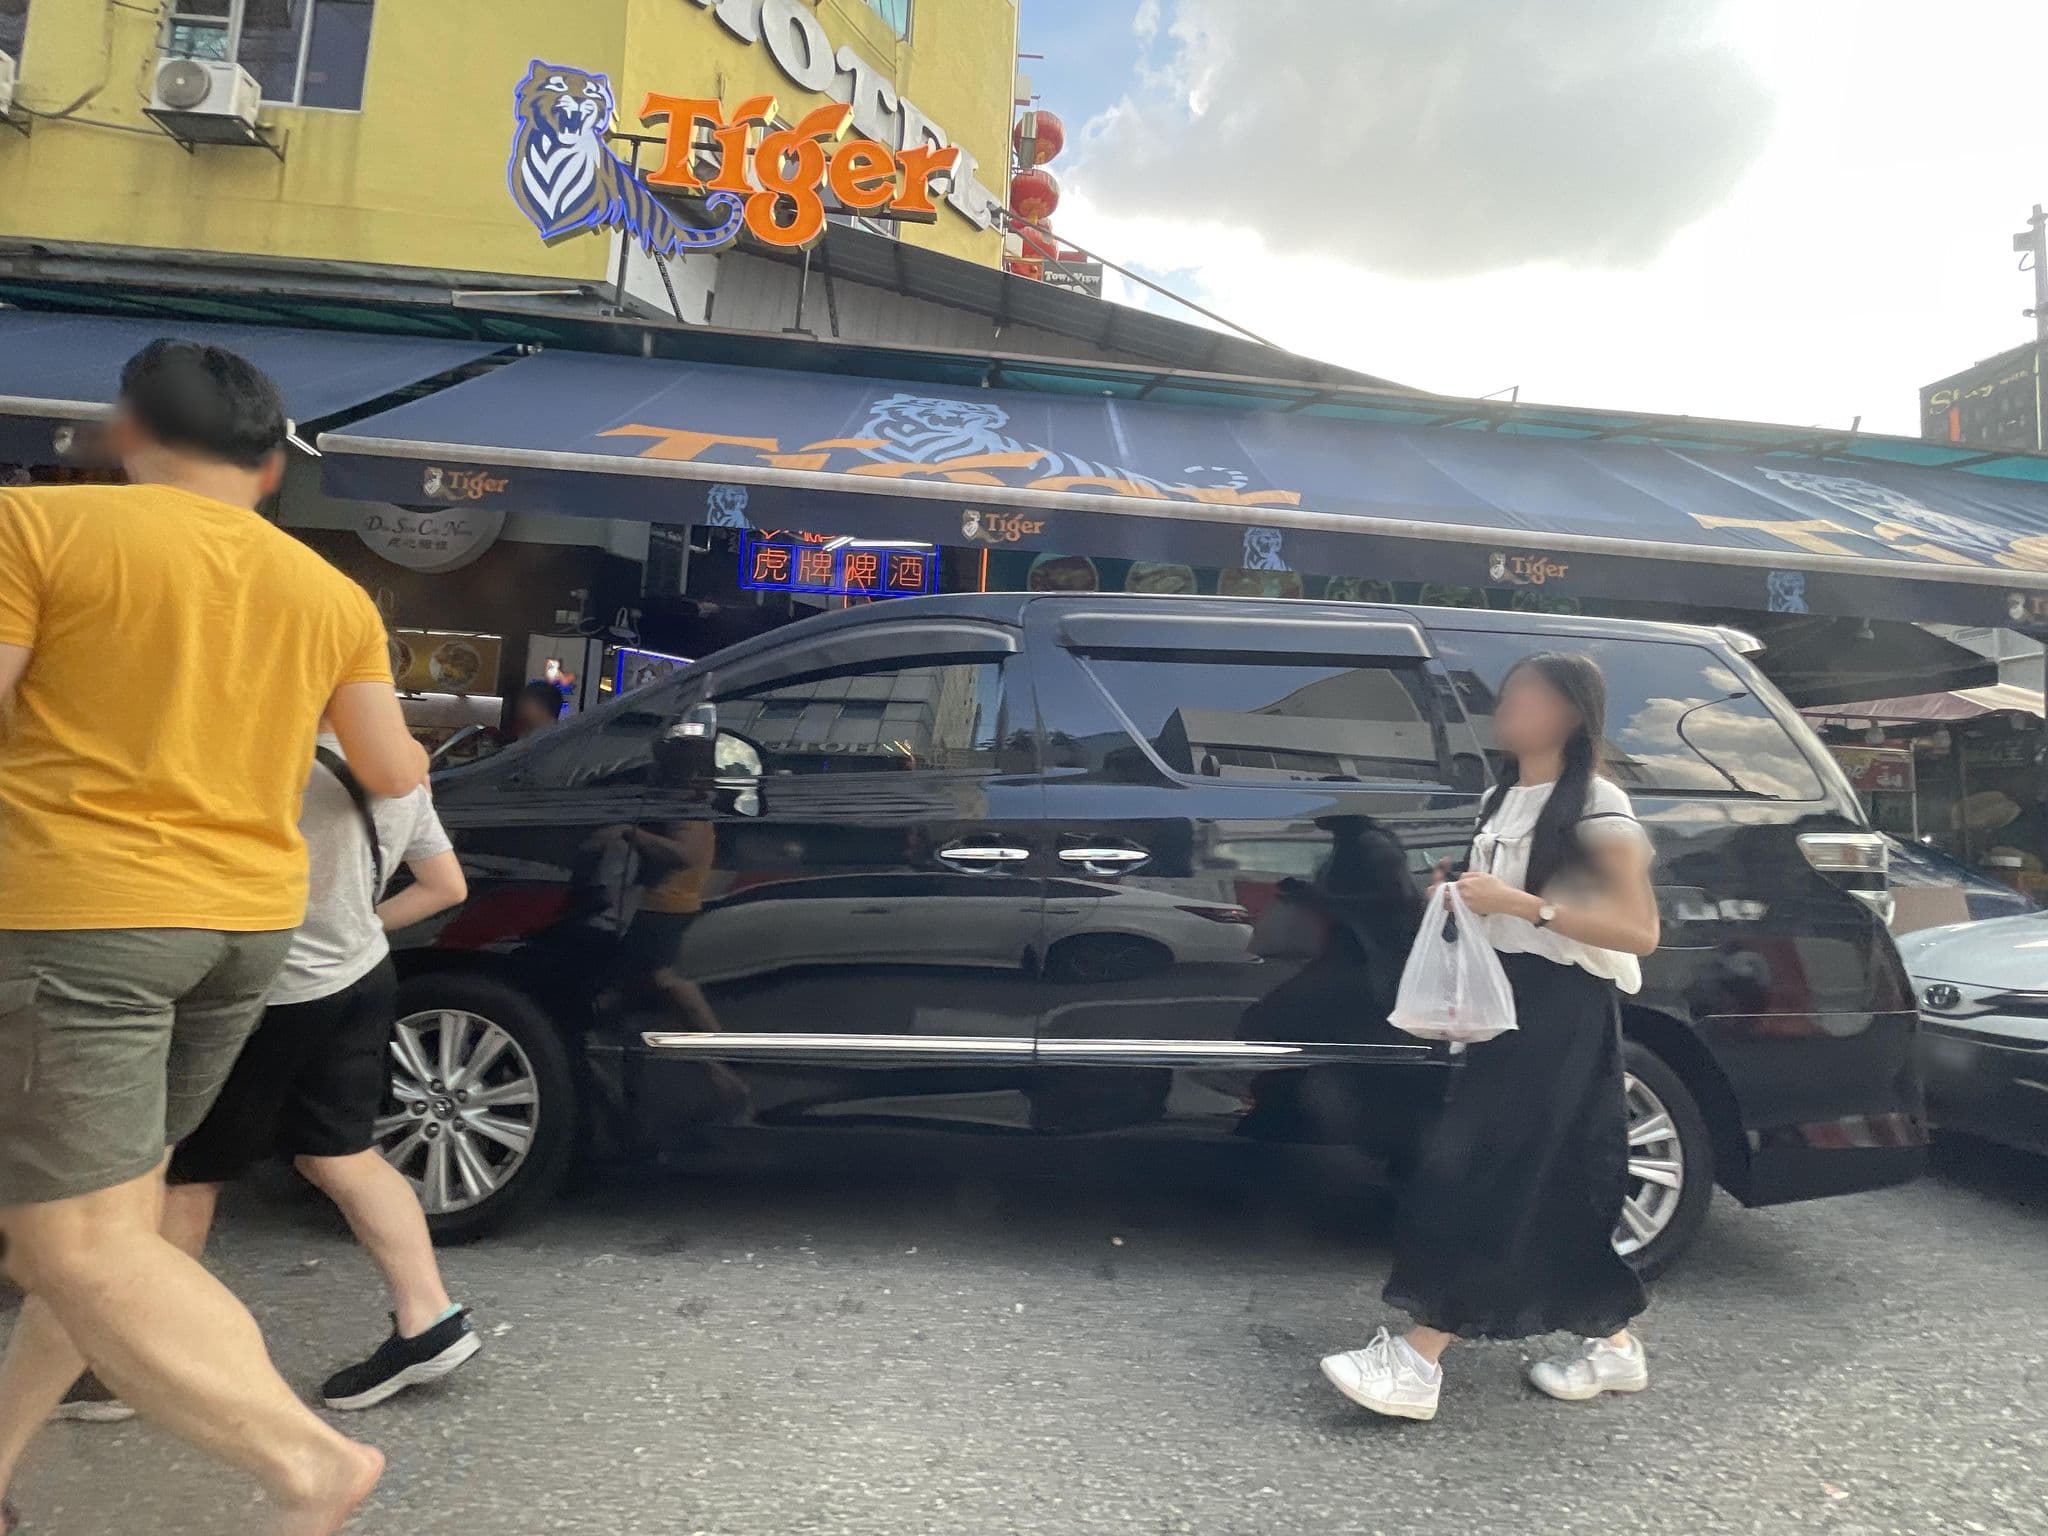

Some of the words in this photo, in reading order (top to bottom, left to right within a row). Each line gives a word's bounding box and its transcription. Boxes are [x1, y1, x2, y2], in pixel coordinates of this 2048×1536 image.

[638, 91, 962, 247] Tiger
[596, 423, 1302, 505] Tir
[447, 470, 509, 500] Tiger
[984, 512, 1046, 541] Tiger
[752, 548, 923, 587] 虎牌啤酒
[1510, 555, 1569, 585] Tiger
